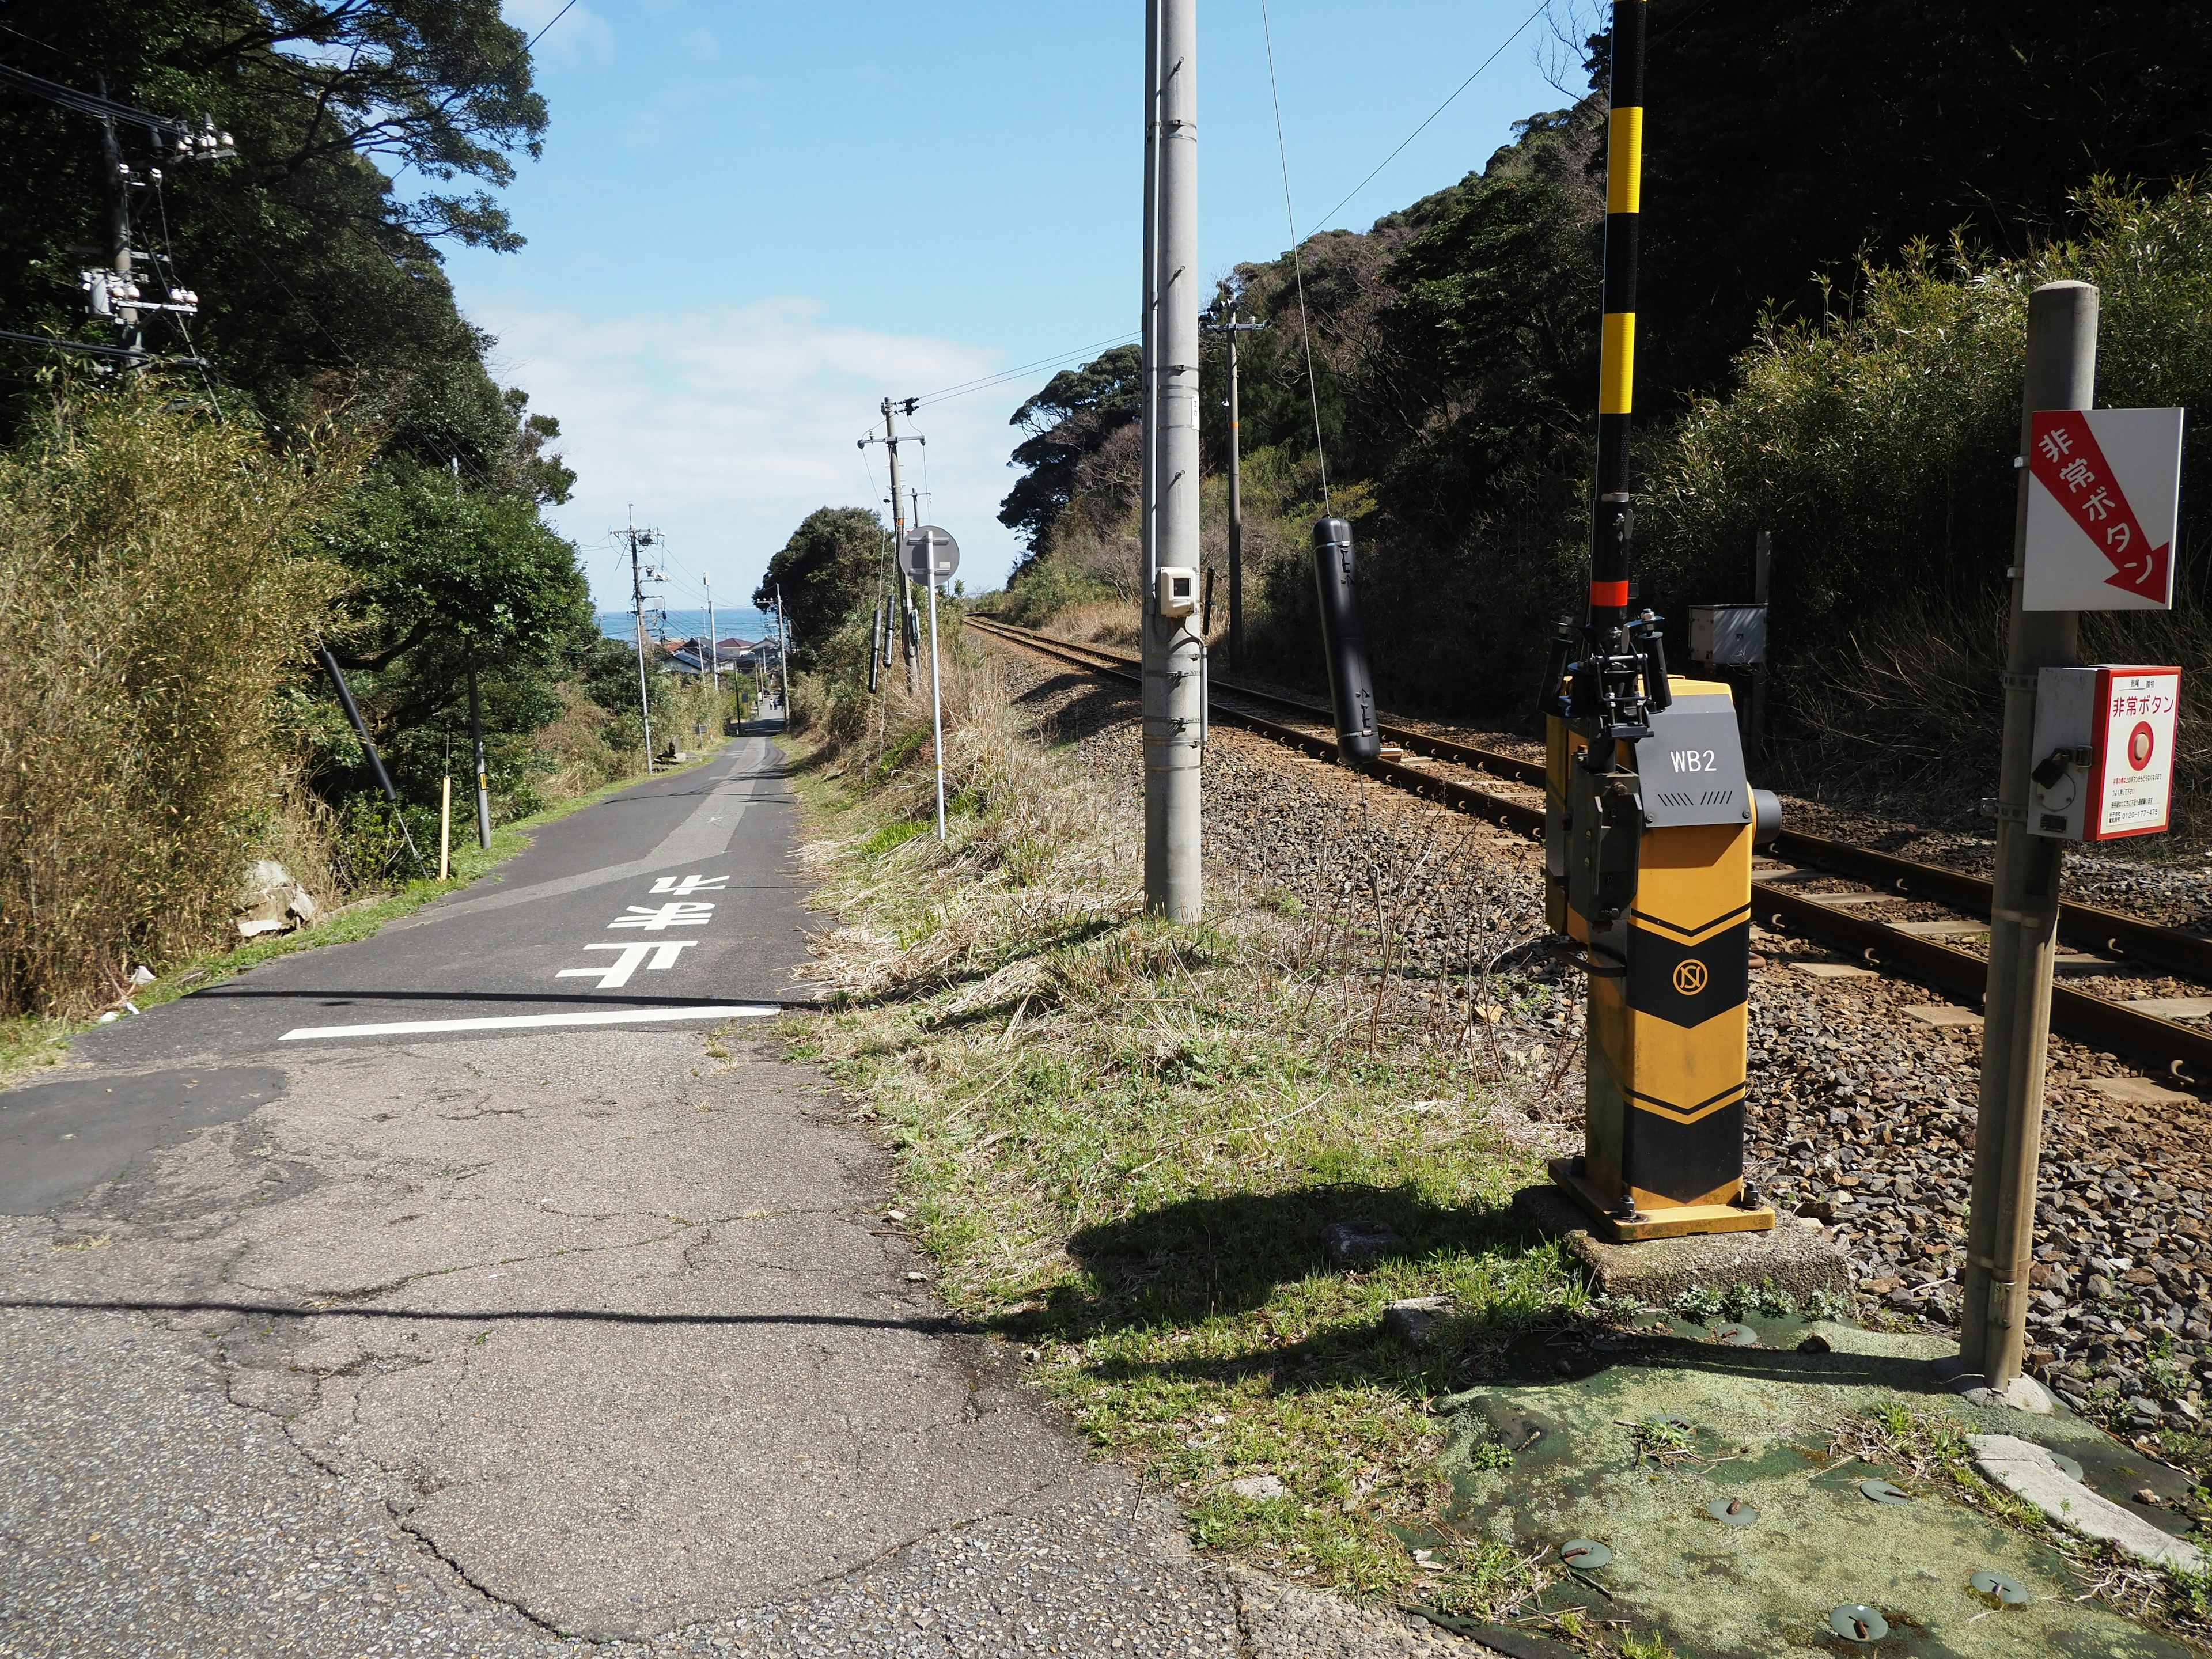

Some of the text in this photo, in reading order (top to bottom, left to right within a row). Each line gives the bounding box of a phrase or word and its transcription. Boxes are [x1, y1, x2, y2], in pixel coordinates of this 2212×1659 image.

[2038, 427, 2153, 584] 非常ボタン
[2146, 680, 2155, 688] 踏切
[2113, 695, 2173, 717] 非常ボタン
[1670, 749, 1717, 773] WB2
[2122, 809, 2158, 819] 0120-177-475
